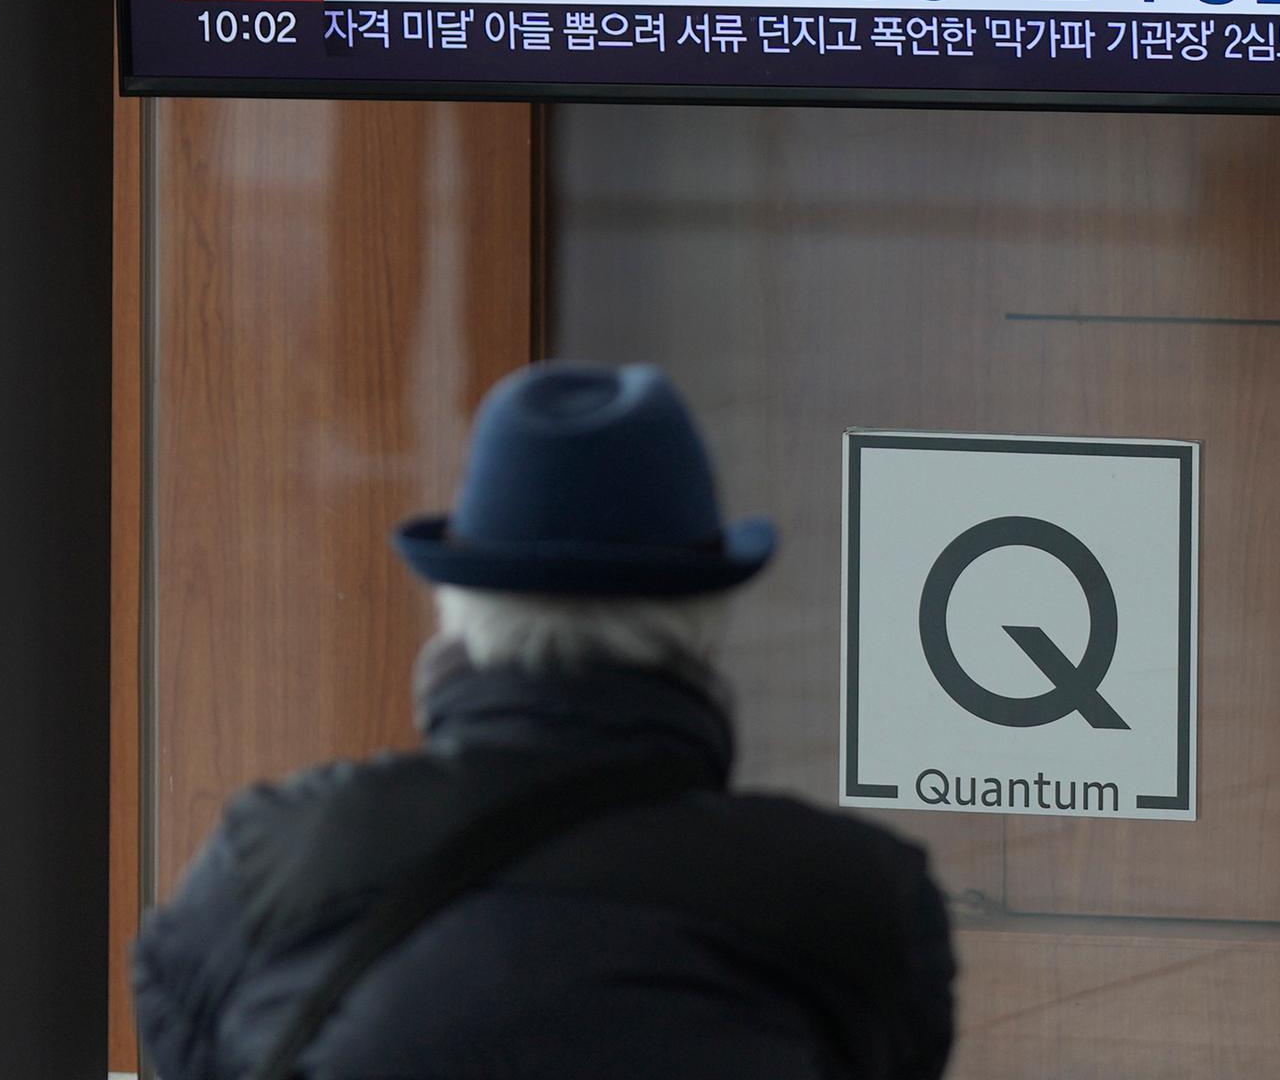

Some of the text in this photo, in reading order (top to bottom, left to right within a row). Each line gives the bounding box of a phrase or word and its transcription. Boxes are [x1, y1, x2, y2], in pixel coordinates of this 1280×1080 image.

[198, 10, 298, 44] 10:02
[324, 8, 391, 50] 자격
[403, 8, 475, 50] 미달'
[485, 11, 555, 51] 아들
[563, 12, 666, 53] 뽑으려
[677, 13, 748, 54] 서류
[758, 14, 863, 56] 던지고
[870, 16, 978, 57] 폭언한
[984, 16, 1097, 60] '막가파
[1107, 19, 1216, 62] 기관장'
[918, 515, 1132, 731] Q
[915, 768, 1120, 812] Quantum
